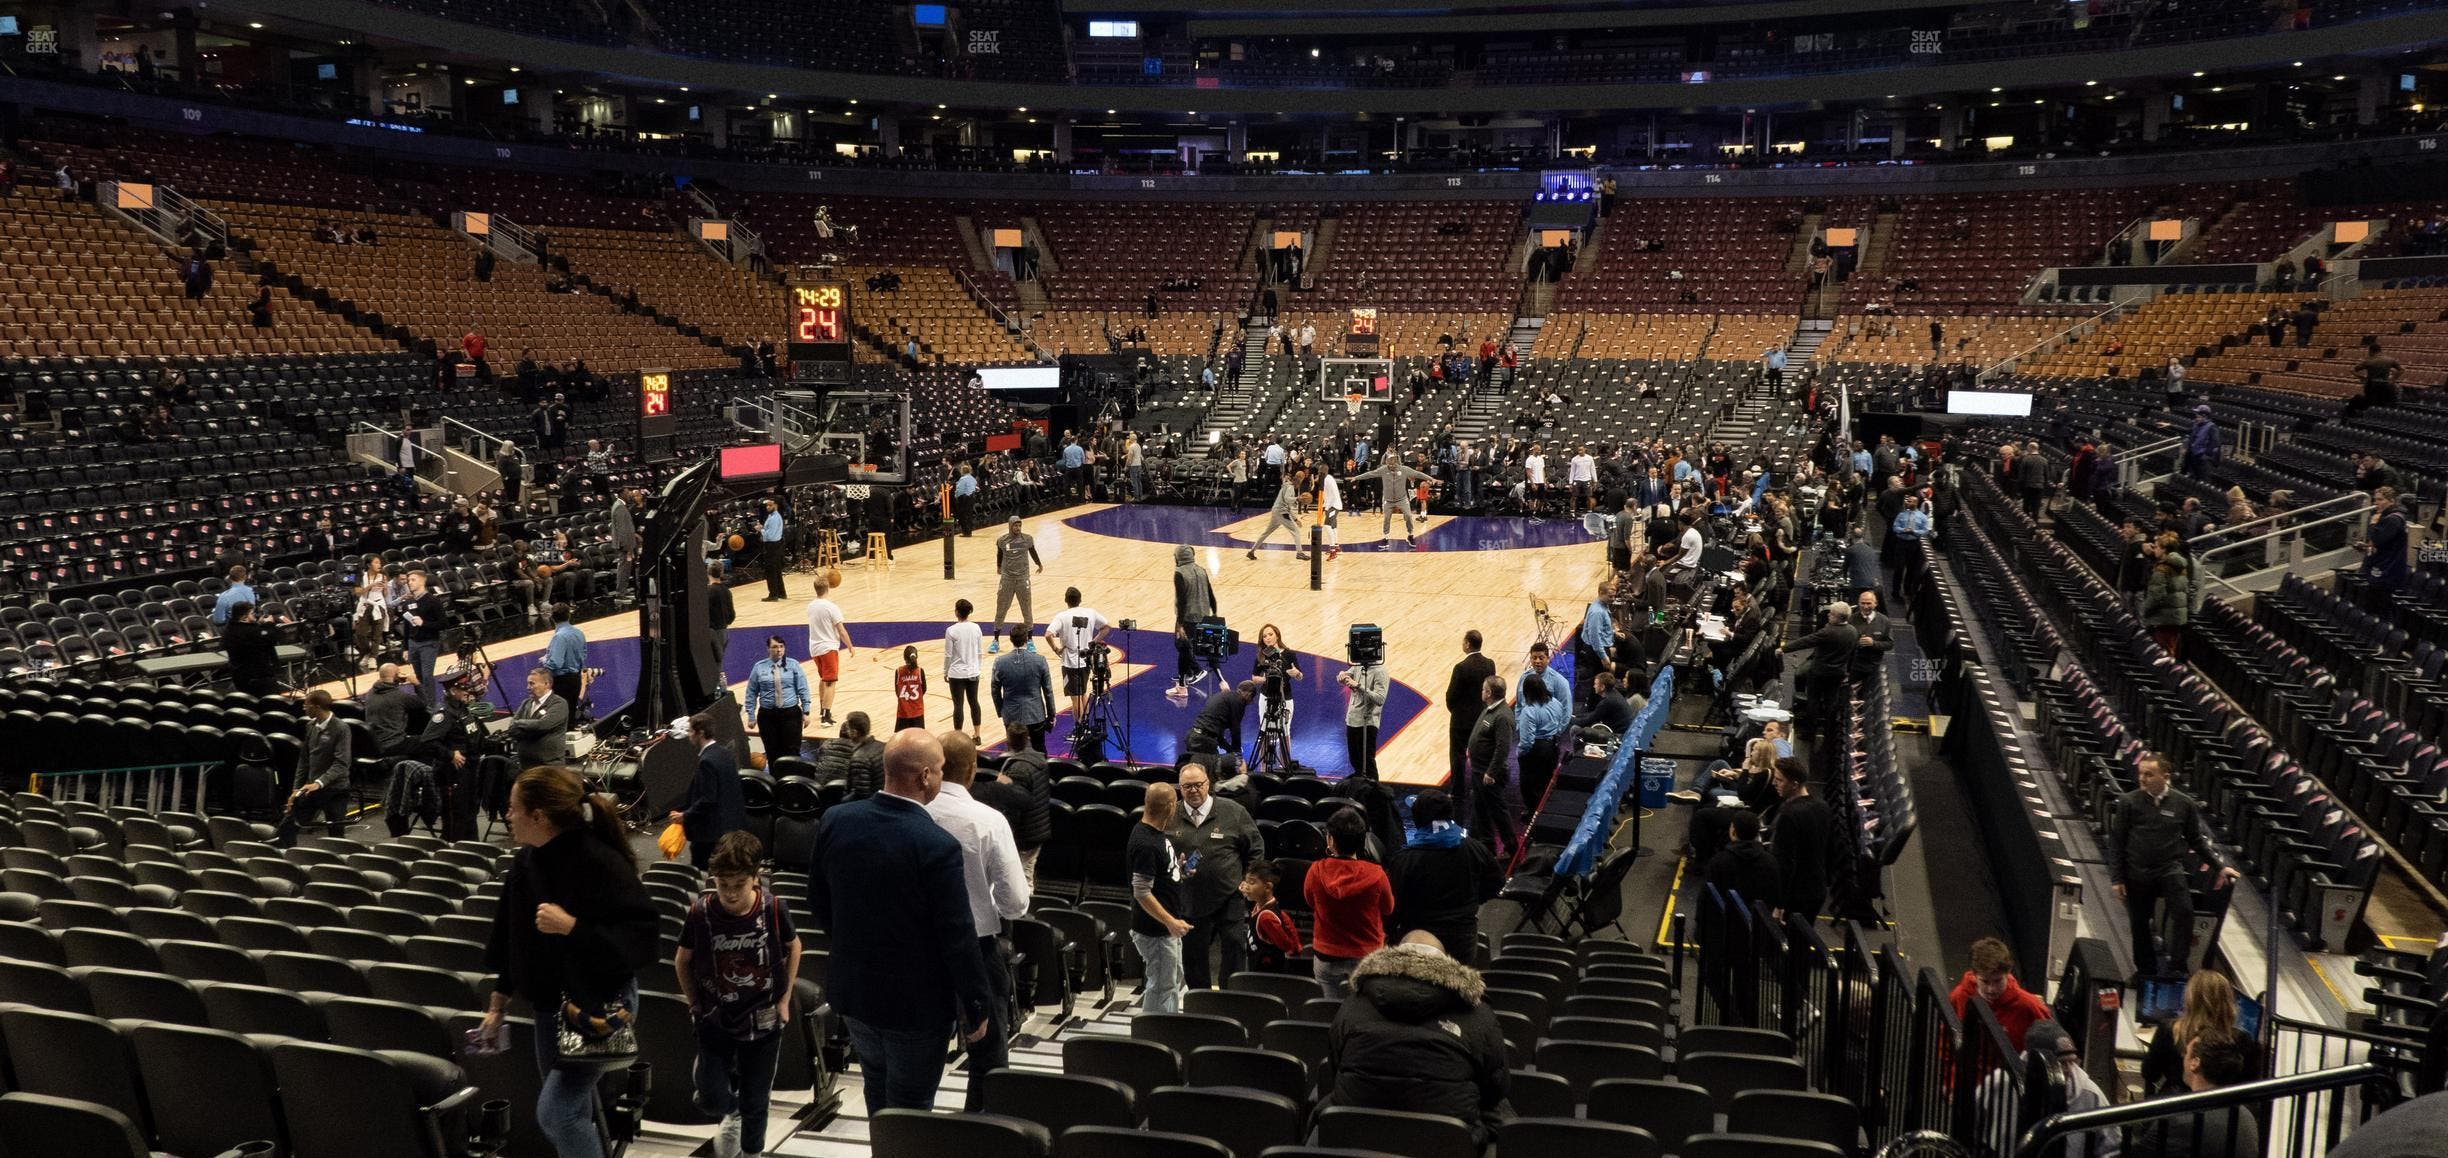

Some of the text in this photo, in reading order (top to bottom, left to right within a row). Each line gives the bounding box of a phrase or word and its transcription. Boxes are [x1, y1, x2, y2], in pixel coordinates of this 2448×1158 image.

[182, 108, 202, 121] 109
[2419, 139, 2437, 150] 116
[496, 148, 511, 158] 110
[809, 171, 822, 180] 111
[2019, 165, 2036, 175] 115
[1141, 179, 1155, 188] 112
[1448, 178, 1461, 187] 113
[1705, 174, 1721, 183] 114
[795, 288, 840, 307] 74:29
[800, 308, 836, 340] 24
[1353, 318, 1374, 335] 24
[648, 393, 665, 414] 24
[899, 685, 920, 701] 43
